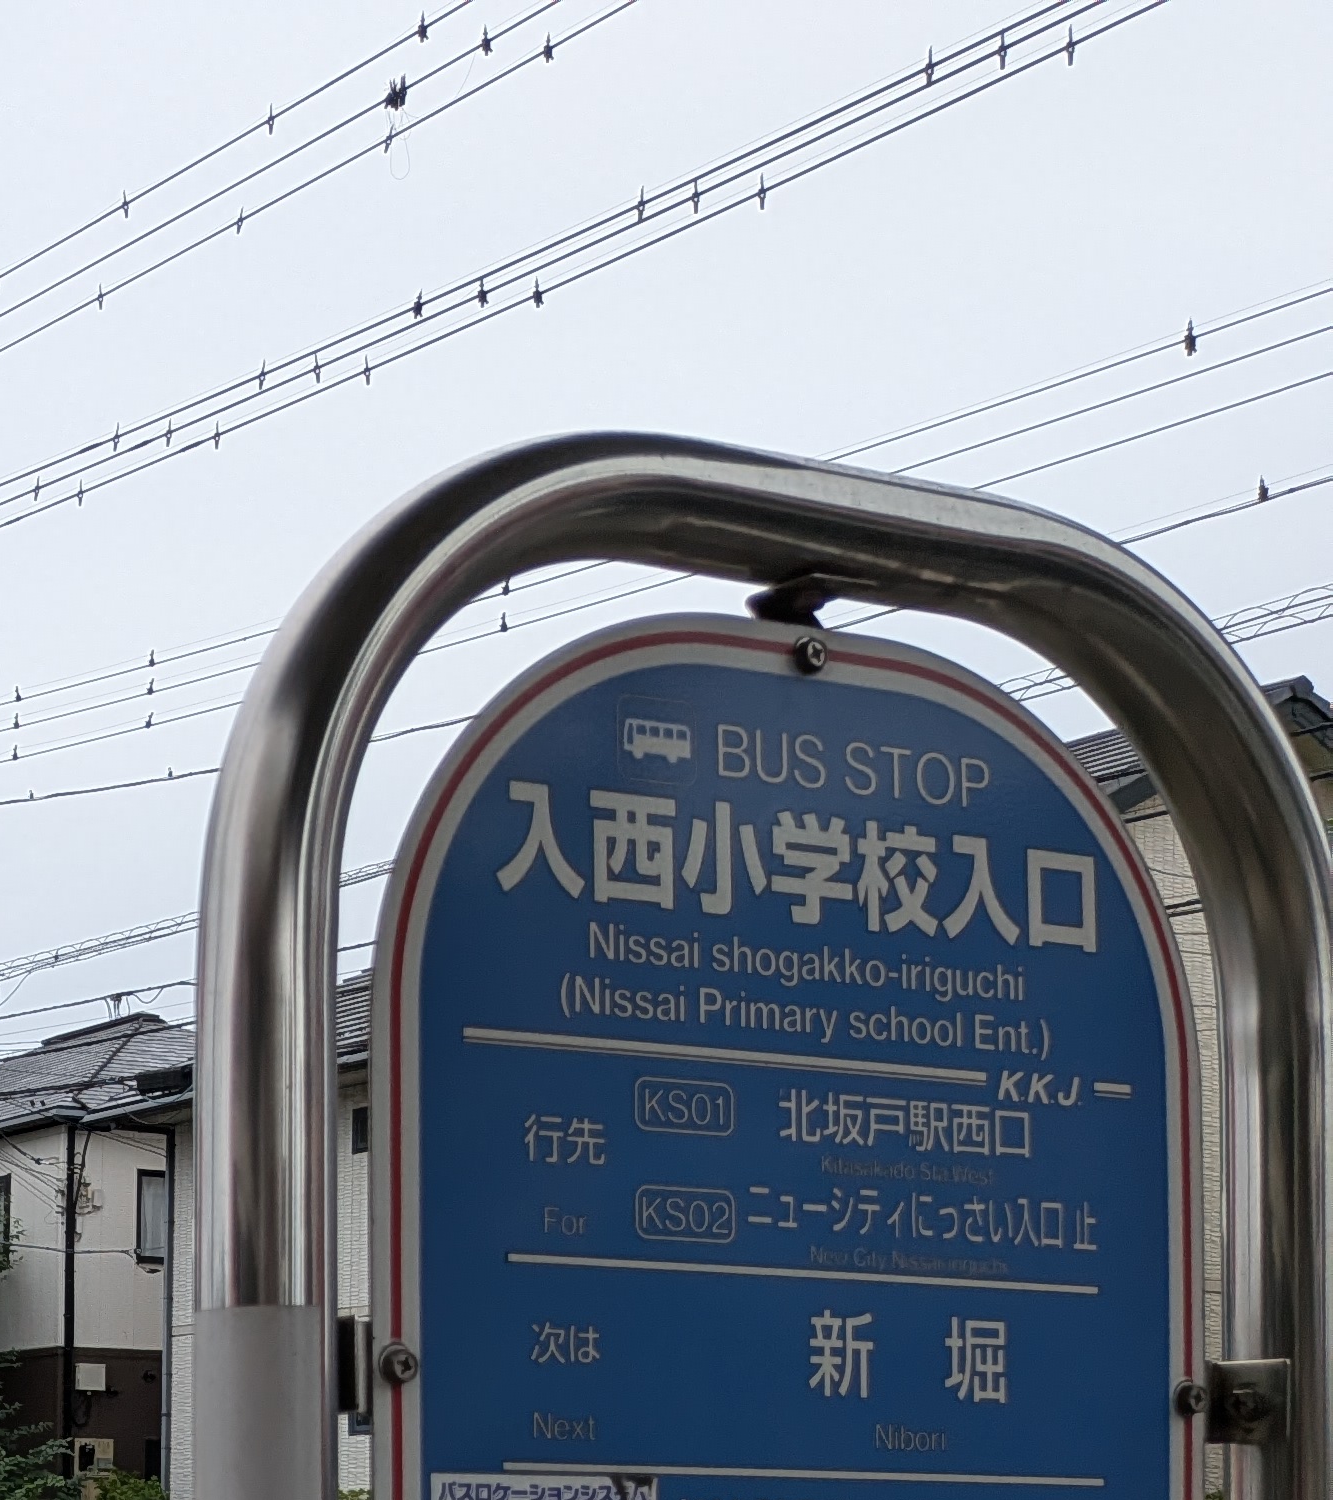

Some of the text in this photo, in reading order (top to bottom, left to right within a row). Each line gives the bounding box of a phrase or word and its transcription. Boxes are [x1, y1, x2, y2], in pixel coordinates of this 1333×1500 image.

[717, 723, 990, 808] BUS STOP
[496, 779, 1099, 954] 入西小学校入口
[588, 921, 1026, 1003] Nissai shogakko-iriguchi
[560, 973, 1051, 1060] (Nissai Primary school Ent.)
[643, 1087, 729, 1128] KS01
[997, 1071, 1083, 1107] K.K.J.
[524, 1113, 607, 1166] 行先
[778, 1088, 1032, 1159] 北坂戸駅西口
[542, 1205, 589, 1236] For
[642, 1193, 731, 1236] KS02
[746, 1185, 1065, 1250] ニューシティにっさい入口
[529, 1320, 601, 1365] 次は
[808, 1308, 1009, 1405] 新堀
[532, 1410, 597, 1442] Next
[874, 1422, 949, 1453] Nibori
